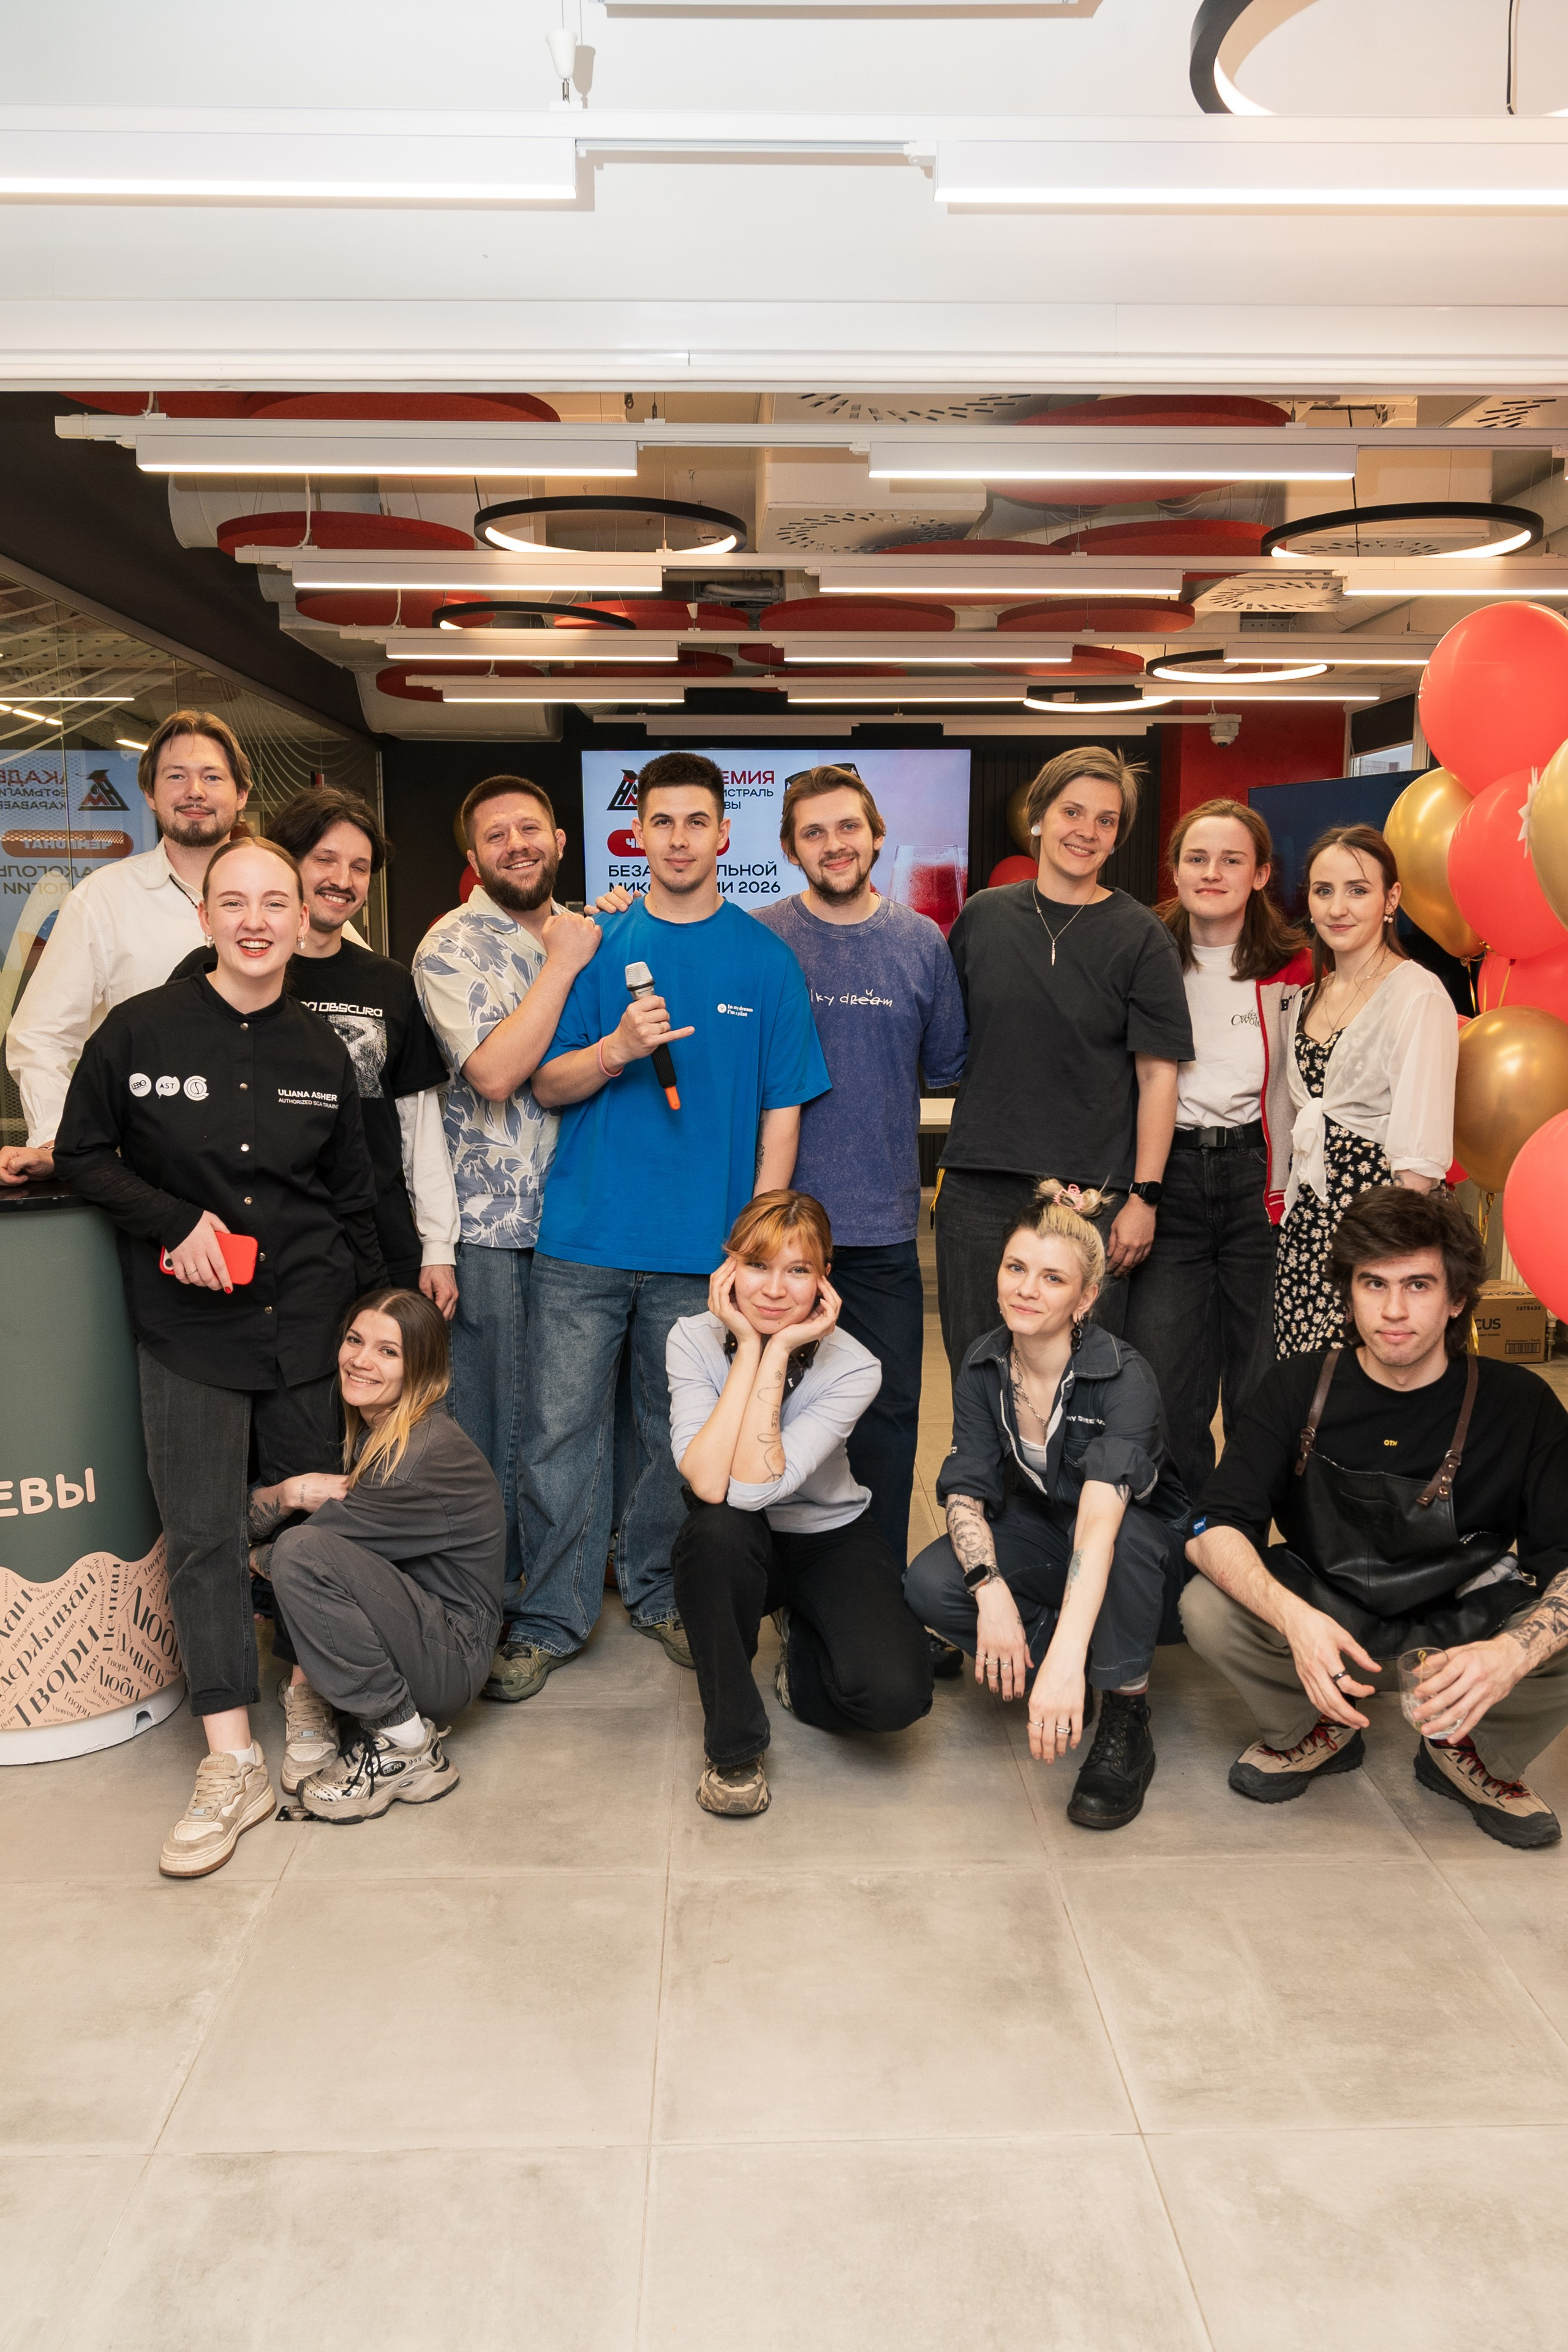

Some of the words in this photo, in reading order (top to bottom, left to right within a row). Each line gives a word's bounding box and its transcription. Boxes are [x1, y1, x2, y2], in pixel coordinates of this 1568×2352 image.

[723, 771, 775, 785] ЕМИЯ
[723, 788, 774, 797] ИСТРАЛЬ
[738, 881, 781, 894] 2026
[277, 1088, 310, 1098] ULIANA
[311, 1091, 337, 1102] ASHER
[1476, 1317, 1501, 1330] CUS
[8, 1624, 100, 1727] Твори
[92, 1665, 140, 1702] Люби
